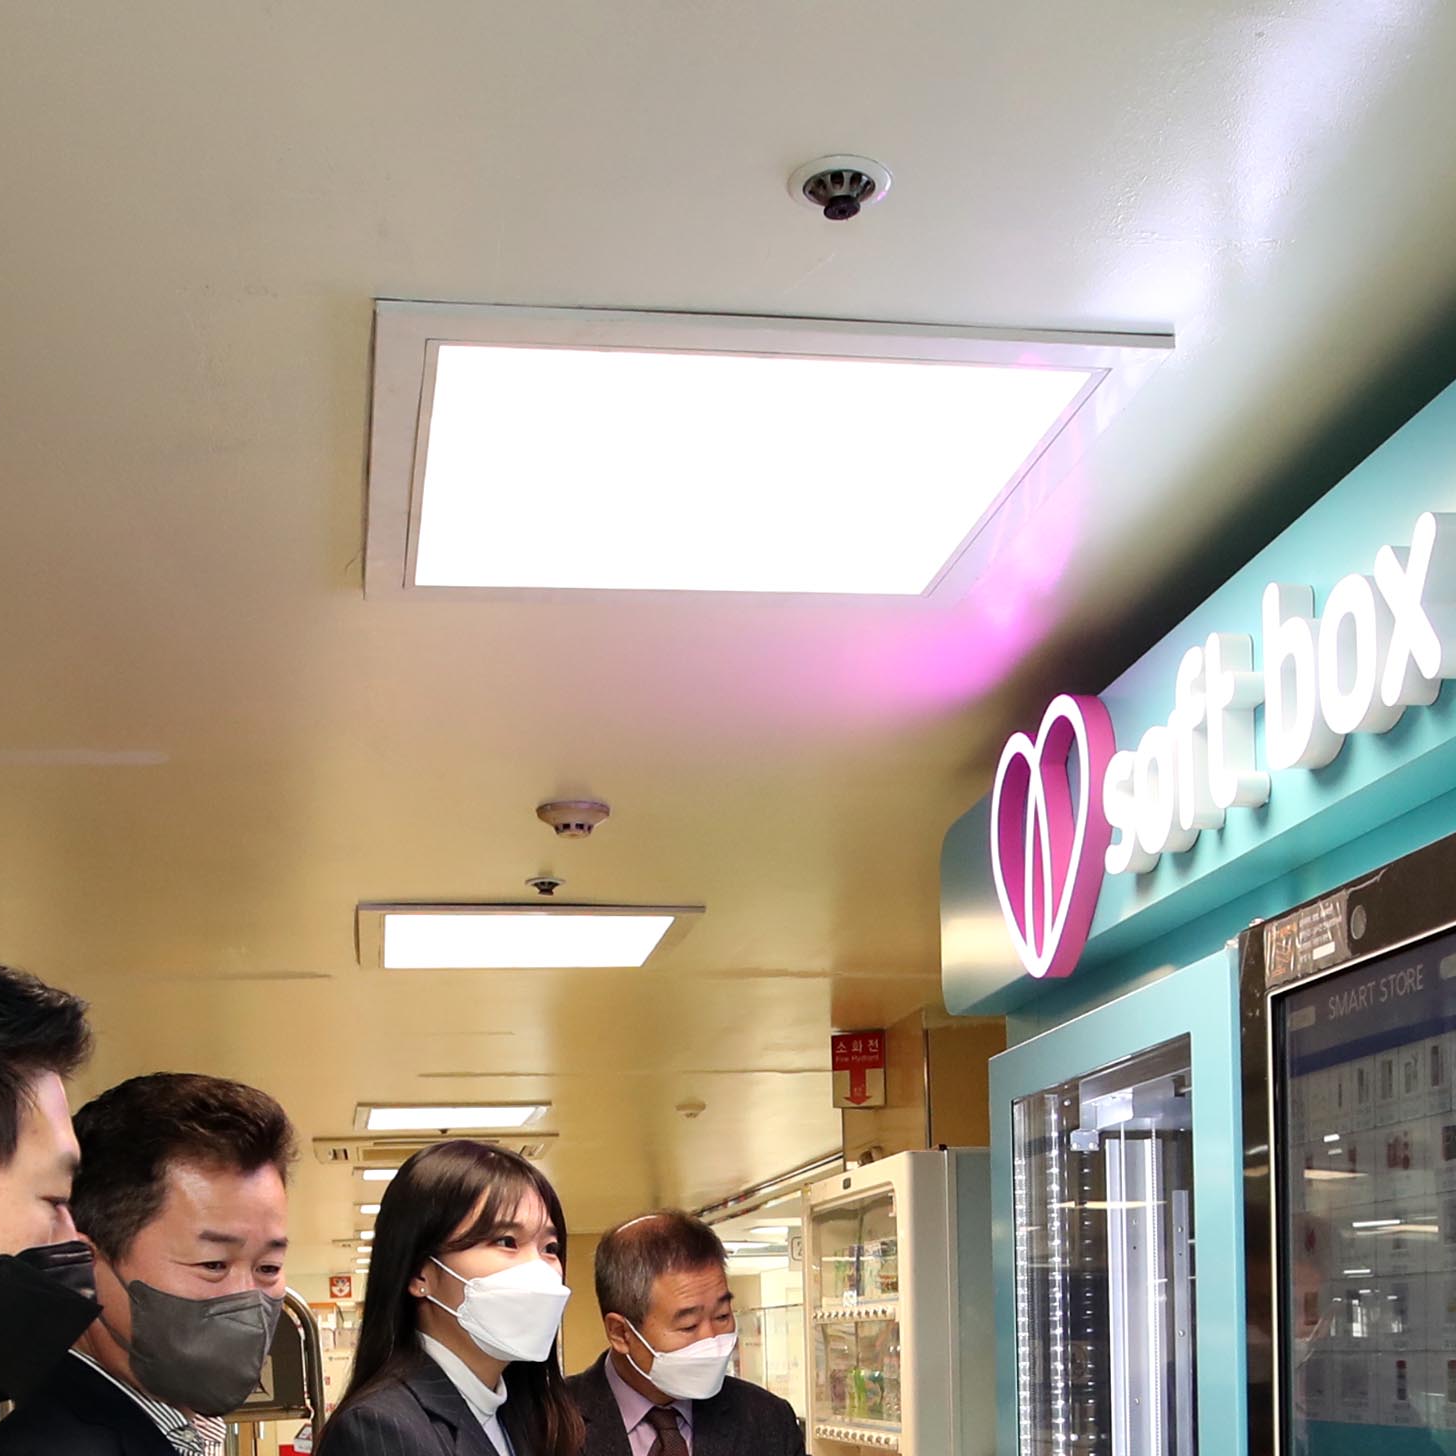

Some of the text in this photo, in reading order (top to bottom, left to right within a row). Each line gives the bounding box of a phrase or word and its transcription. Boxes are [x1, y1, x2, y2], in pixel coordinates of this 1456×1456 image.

[1102, 632, 1271, 875] soft
[1327, 964, 1424, 1020] SMART STORE
